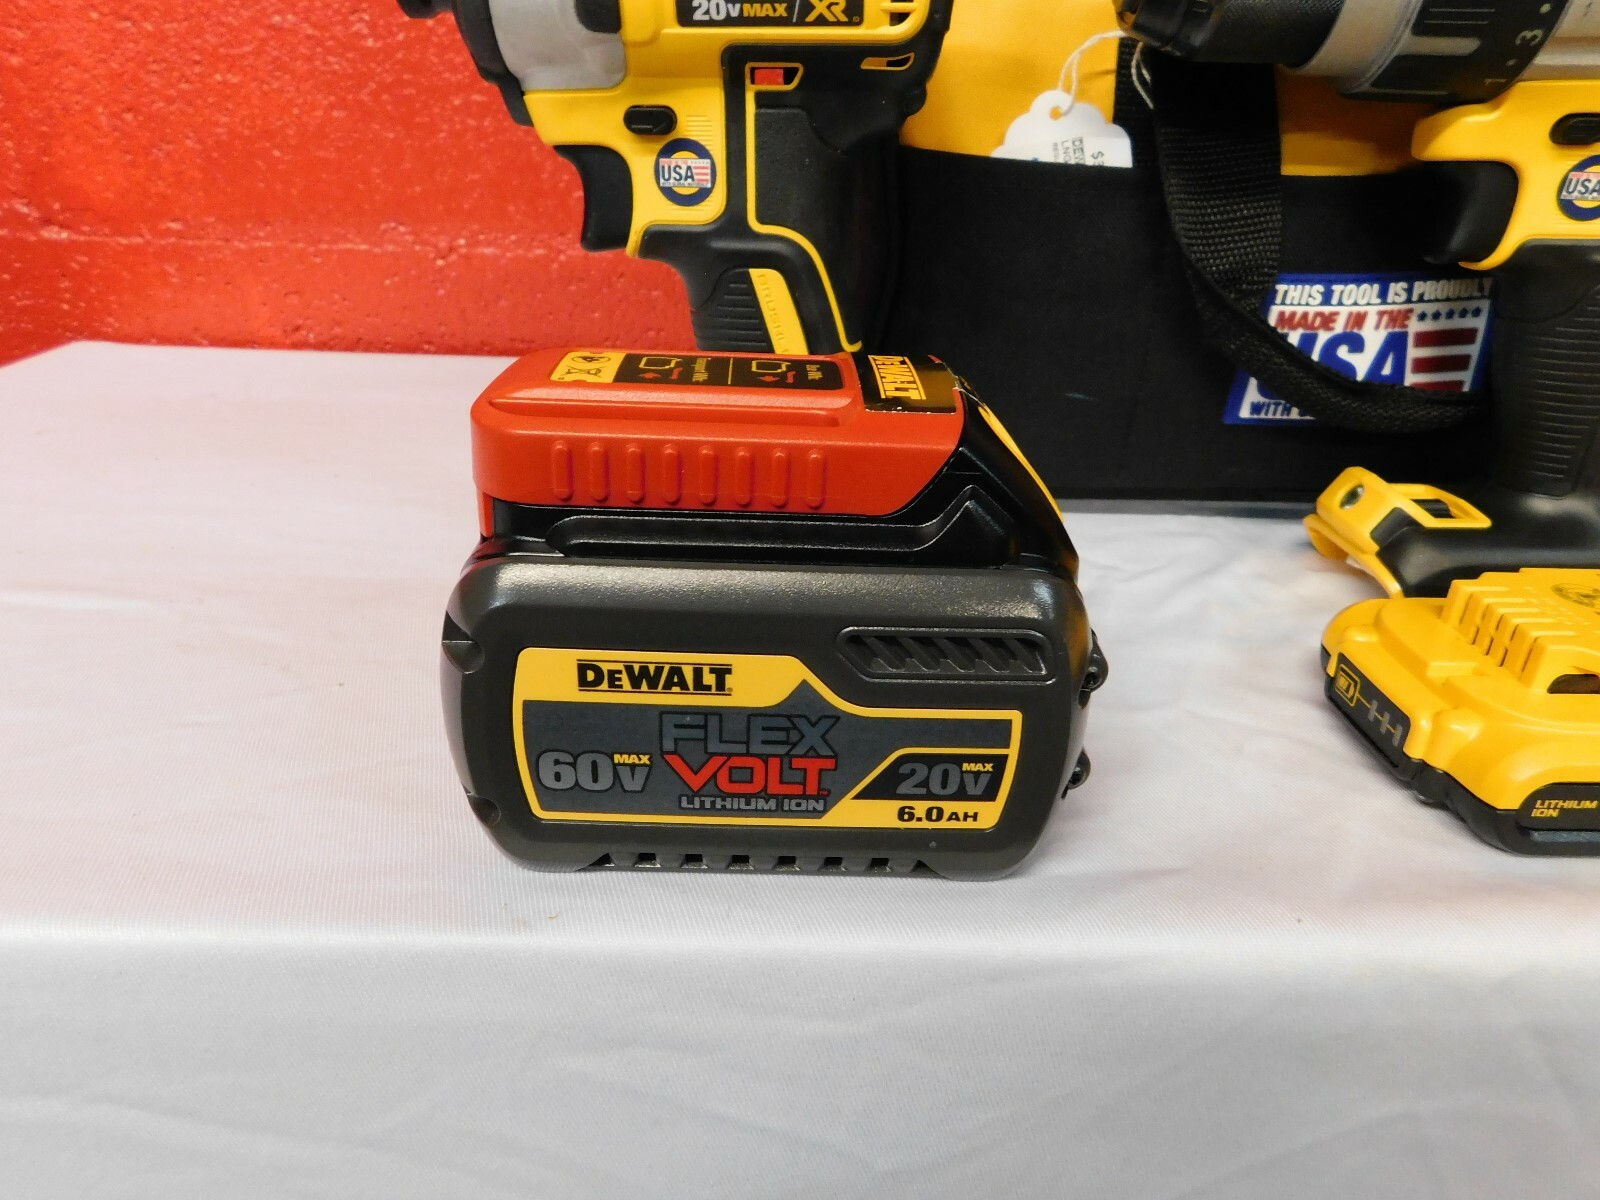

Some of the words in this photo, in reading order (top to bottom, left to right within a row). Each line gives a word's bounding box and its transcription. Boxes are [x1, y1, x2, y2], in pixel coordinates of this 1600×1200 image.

[743, 3, 787, 17] MAX
[805, 0, 849, 22] XR
[1515, 29, 1543, 46] 3
[661, 164, 695, 182] USA
[1275, 284, 1325, 305] THIS
[1331, 283, 1381, 305] TOOL
[1387, 282, 1408, 303] IS
[1411, 278, 1493, 301] PROUDLY
[1274, 311, 1340, 331] MADE
[1343, 310, 1368, 330] IN
[1374, 308, 1414, 330] THE
[1249, 401, 1292, 417] WITH
[660, 711, 840, 755] FLEX
[538, 751, 650, 792] 60V
[614, 753, 651, 764] MAX
[663, 755, 836, 795] VOLT
[896, 763, 992, 795] 20V
[962, 762, 994, 771] MAX
[681, 796, 777, 811] LITHIUM
[784, 799, 824, 811] ION
[1531, 808, 1560, 817] ION
[1535, 799, 1599, 809] LITHIUM
